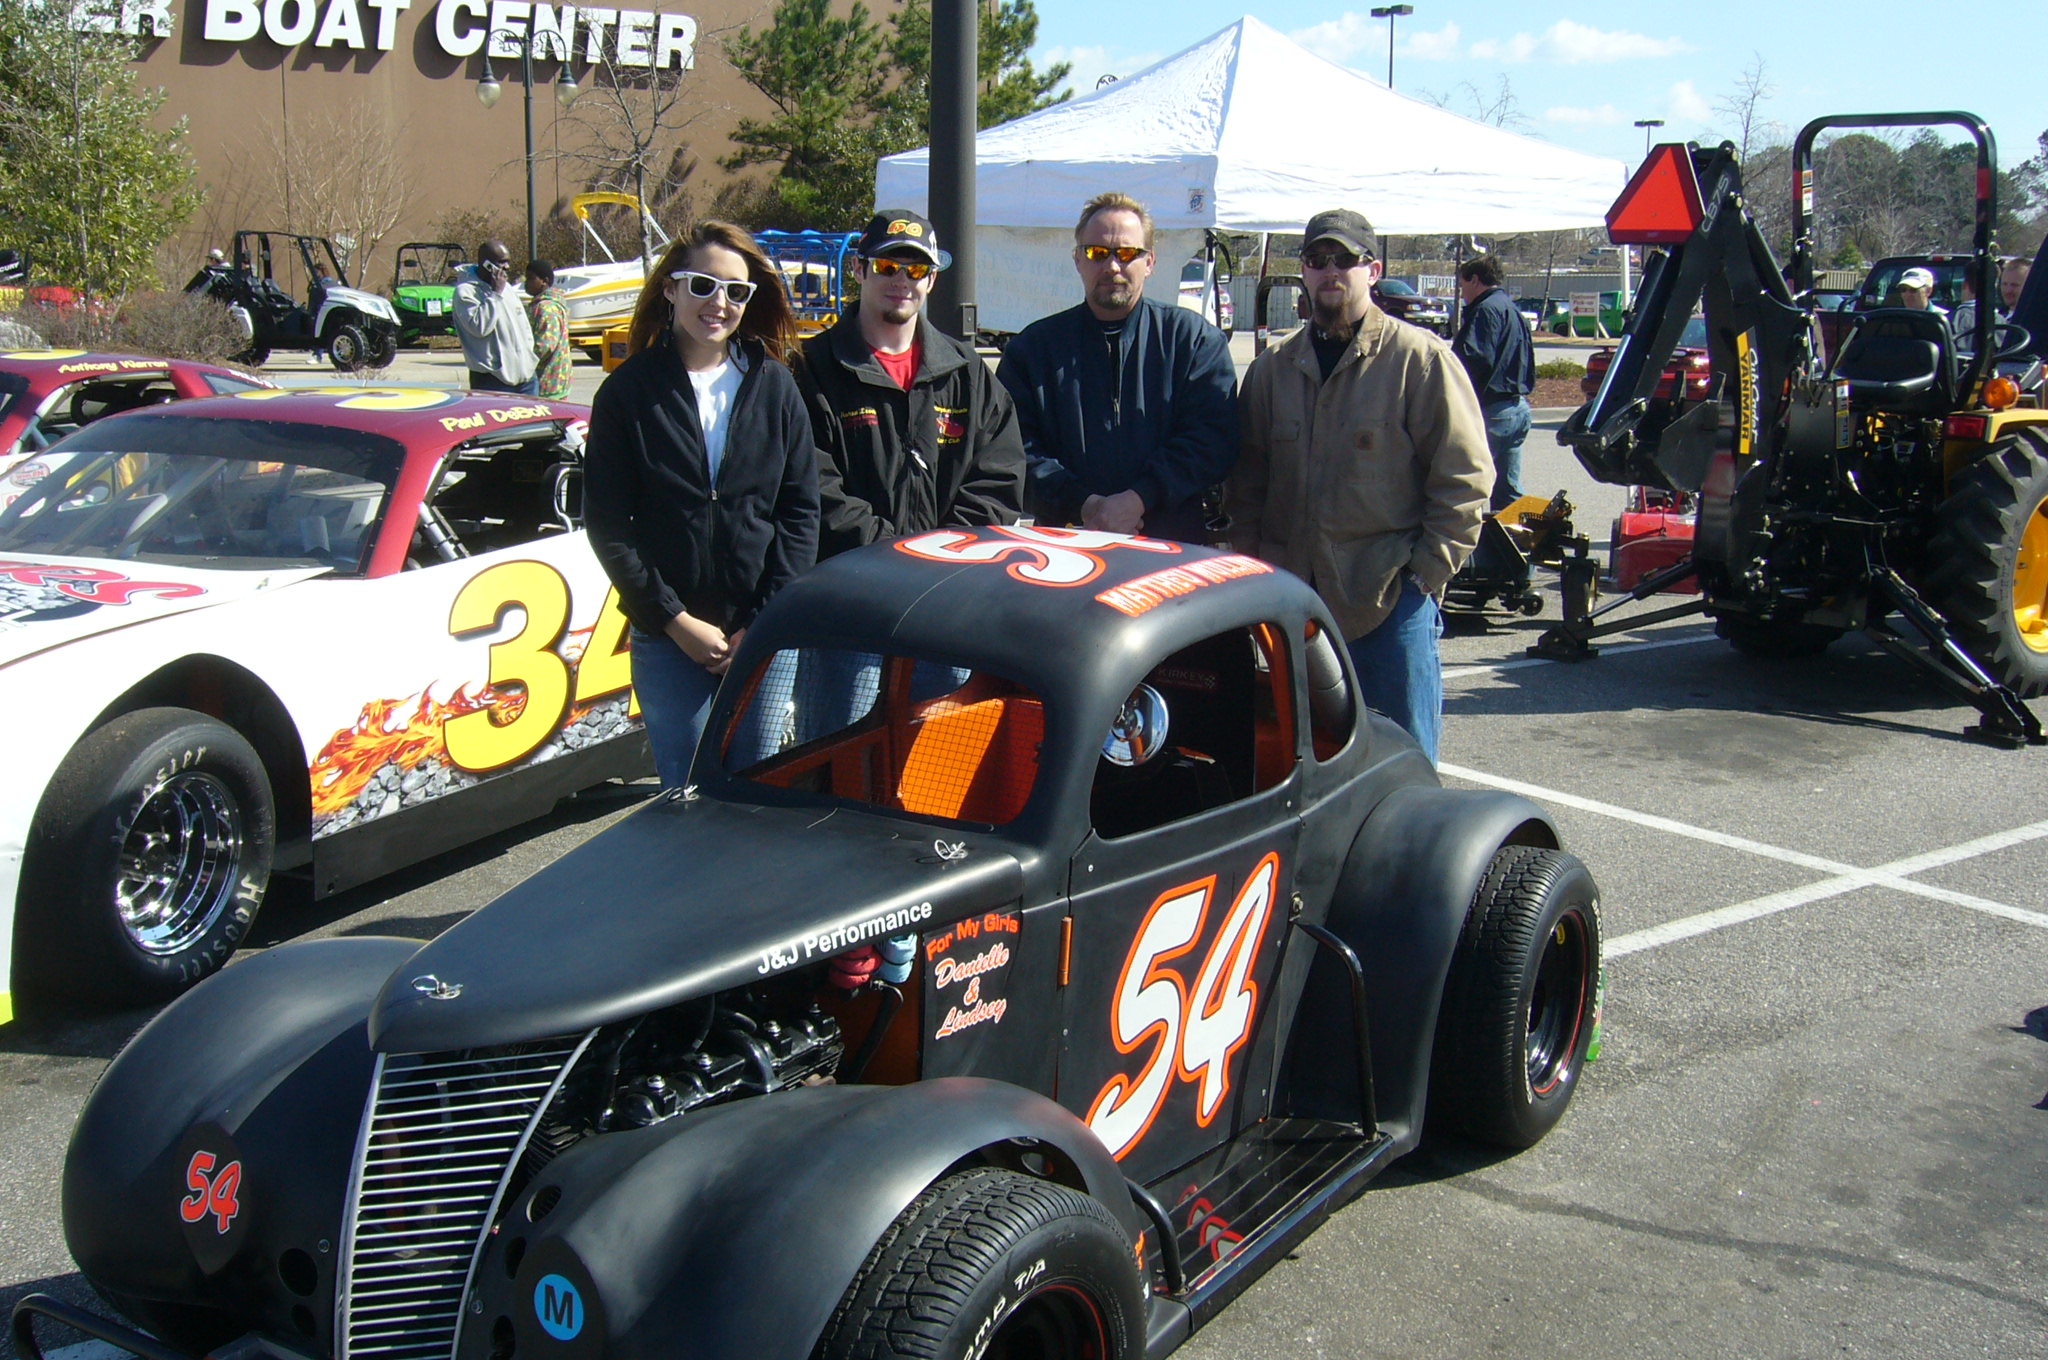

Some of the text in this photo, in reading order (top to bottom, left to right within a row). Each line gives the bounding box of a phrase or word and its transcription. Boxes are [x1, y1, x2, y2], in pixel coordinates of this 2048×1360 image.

[204, 0, 409, 50] BOAT
[435, 0, 697, 70] CENTER
[58, 359, 169, 374] Anthony Warren
[439, 404, 552, 432] Paul DeBolt
[1740, 352, 1751, 440] YANMAR
[757, 901, 932, 974] J&J Performance
[926, 913, 1020, 961] For My Girls
[934, 942, 1010, 990] Danielle
[963, 976, 980, 1007] &
[1084, 851, 1280, 1163] 54
[935, 998, 1007, 1040] Lindsey
[180, 1150, 242, 1235] 54
[1013, 1258, 1047, 1292] T/A
[543, 1283, 574, 1330] M
